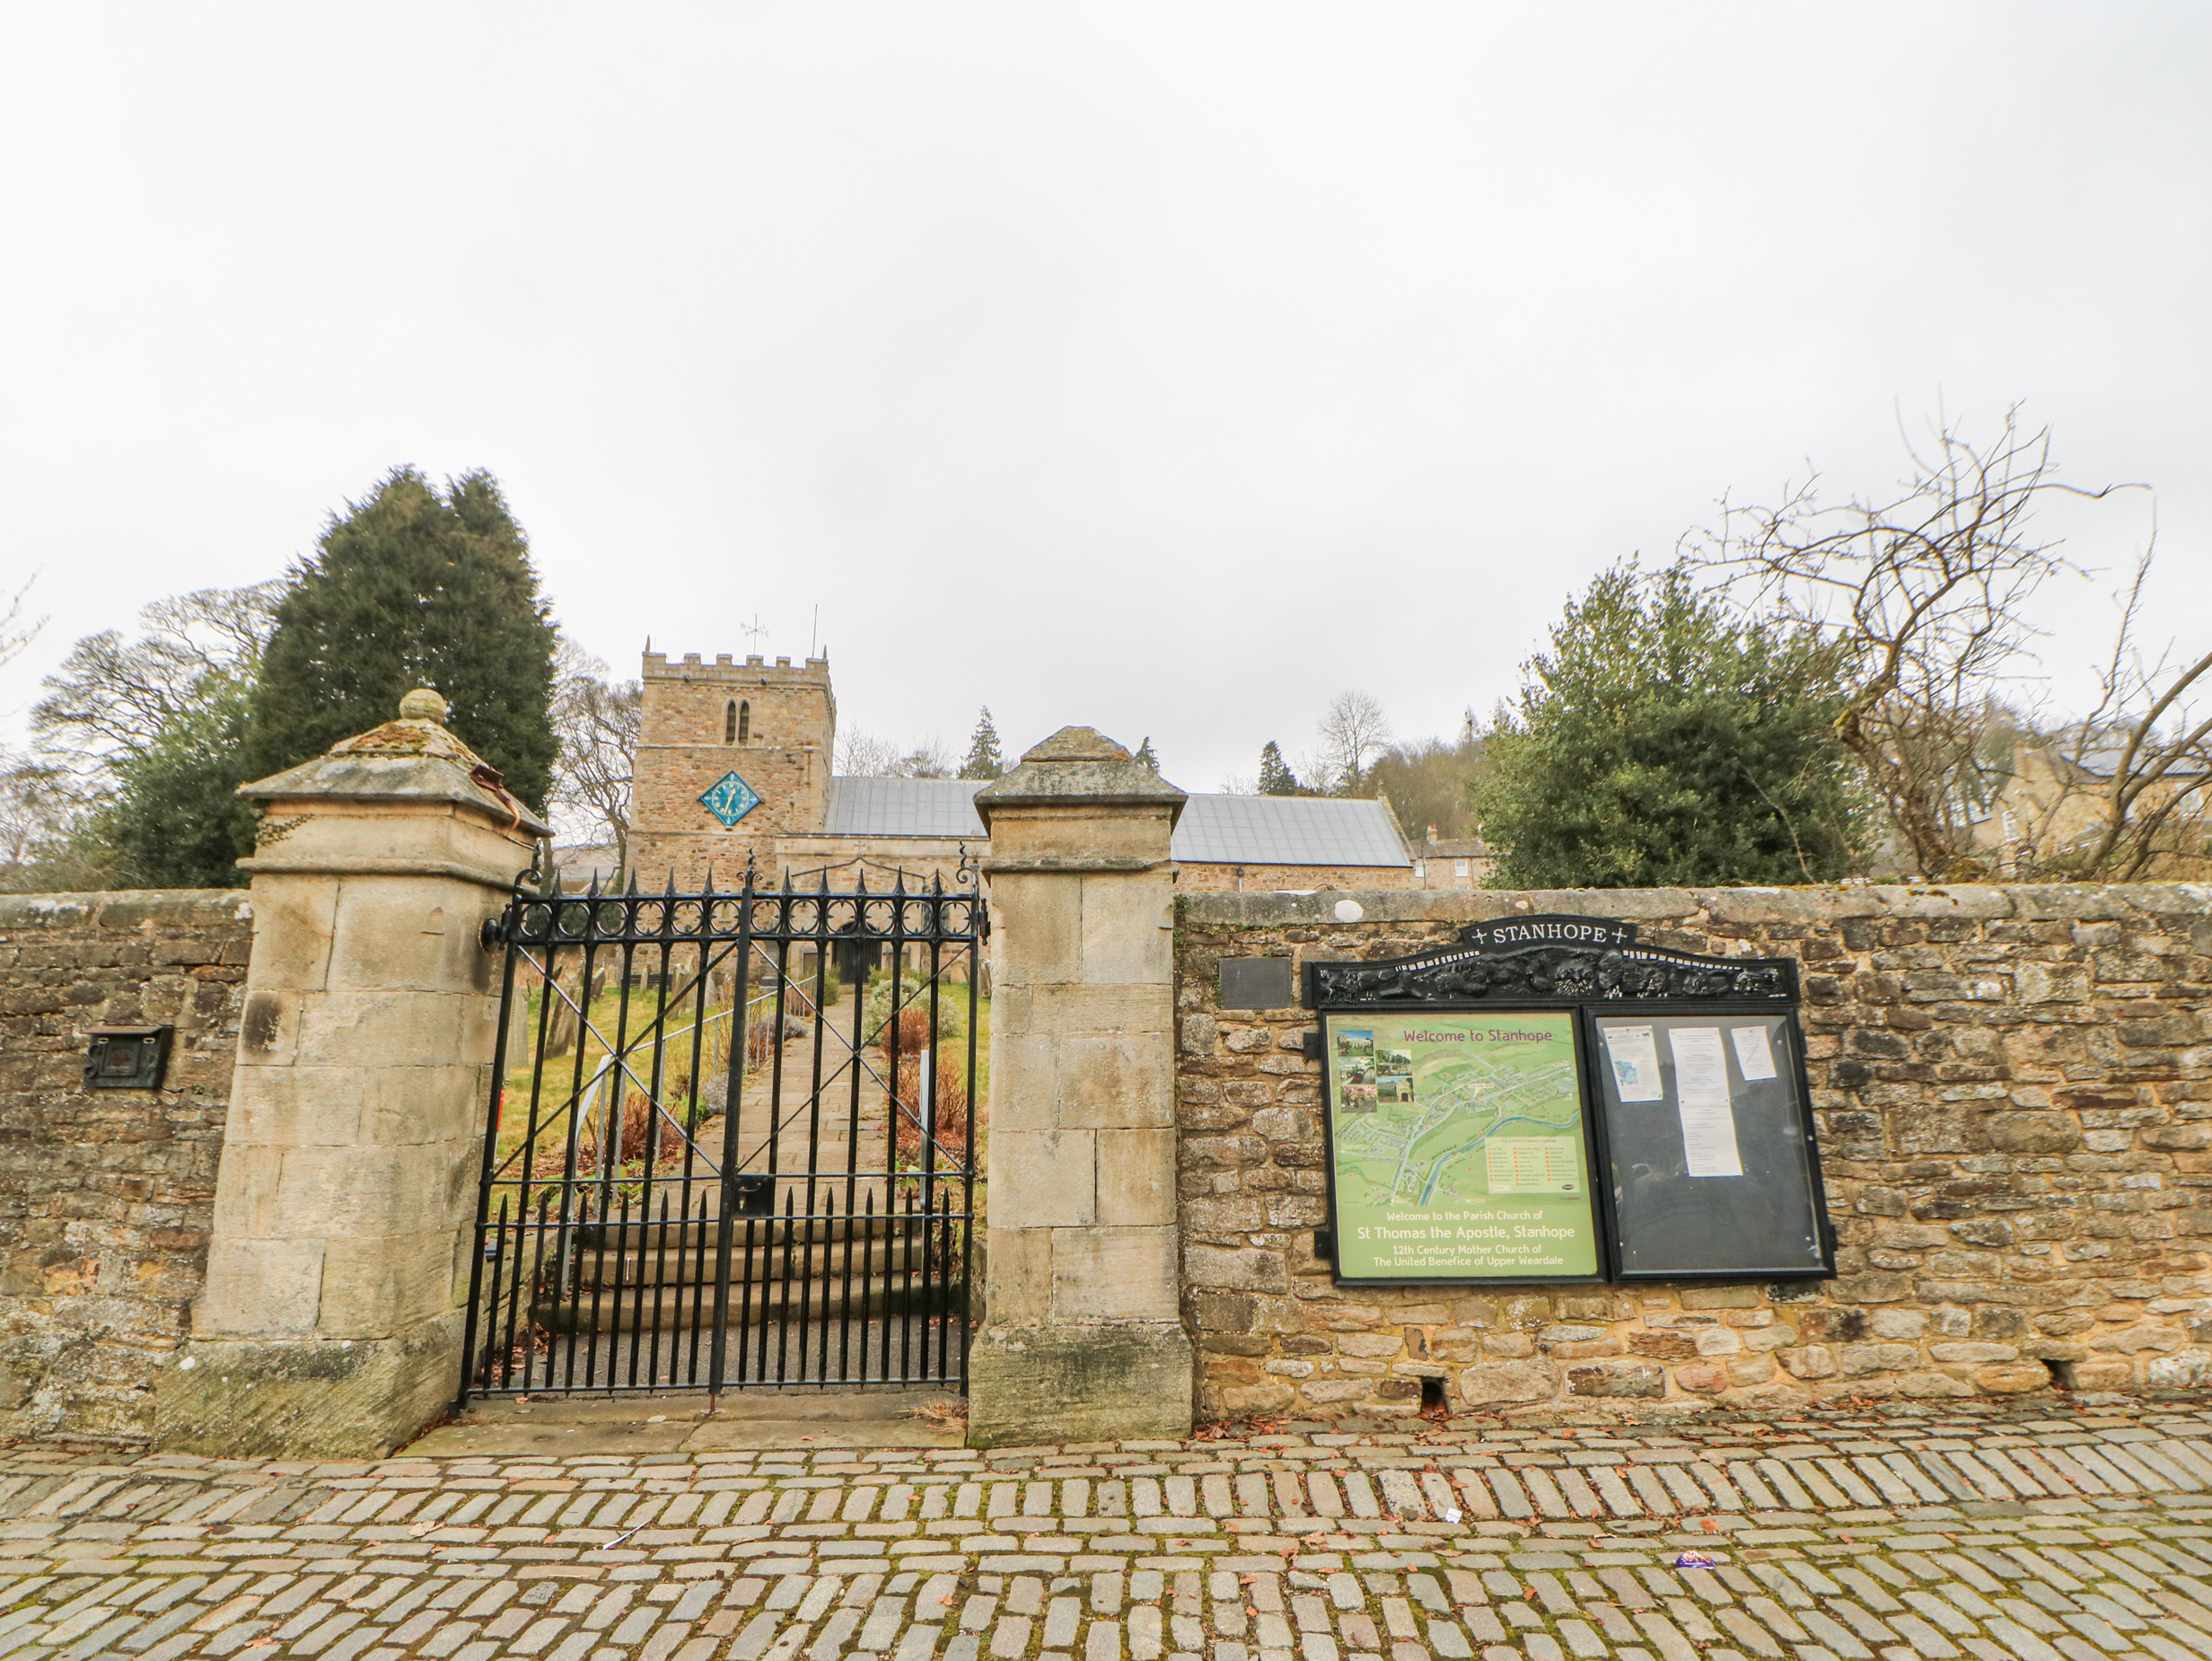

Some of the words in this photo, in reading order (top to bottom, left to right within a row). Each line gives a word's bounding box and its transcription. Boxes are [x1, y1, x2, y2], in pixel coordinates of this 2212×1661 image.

[1493, 924, 1607, 944] STANHOPE
[1403, 1030, 1465, 1042] Welcome
[1470, 1031, 1483, 1041] to
[1488, 1029, 1552, 1043] Stanhope
[1386, 1212, 1430, 1221] Welcome
[1432, 1212, 1443, 1220] to
[1445, 1211, 1461, 1220] the
[1463, 1210, 1494, 1220] Parish
[1497, 1210, 1531, 1220] Church
[1533, 1210, 1543, 1220] of
[1357, 1226, 1370, 1239] St
[1374, 1226, 1426, 1239] Thomas
[1430, 1226, 1451, 1238] the
[1456, 1226, 1510, 1241] Apostle,
[1514, 1226, 1575, 1240] Stanhope
[1392, 1245, 1414, 1254] 12th
[1417, 1245, 1455, 1256] Century
[1458, 1244, 1492, 1254] Mother
[1495, 1244, 1530, 1253] Church
[1532, 1244, 1541, 1253] of
[1374, 1257, 1391, 1267] The
[1394, 1257, 1426, 1266] United
[1428, 1256, 1471, 1266] Benefice
[1474, 1256, 1484, 1265] of
[1487, 1256, 1515, 1268] Upper
[1518, 1255, 1563, 1265] Weardale
